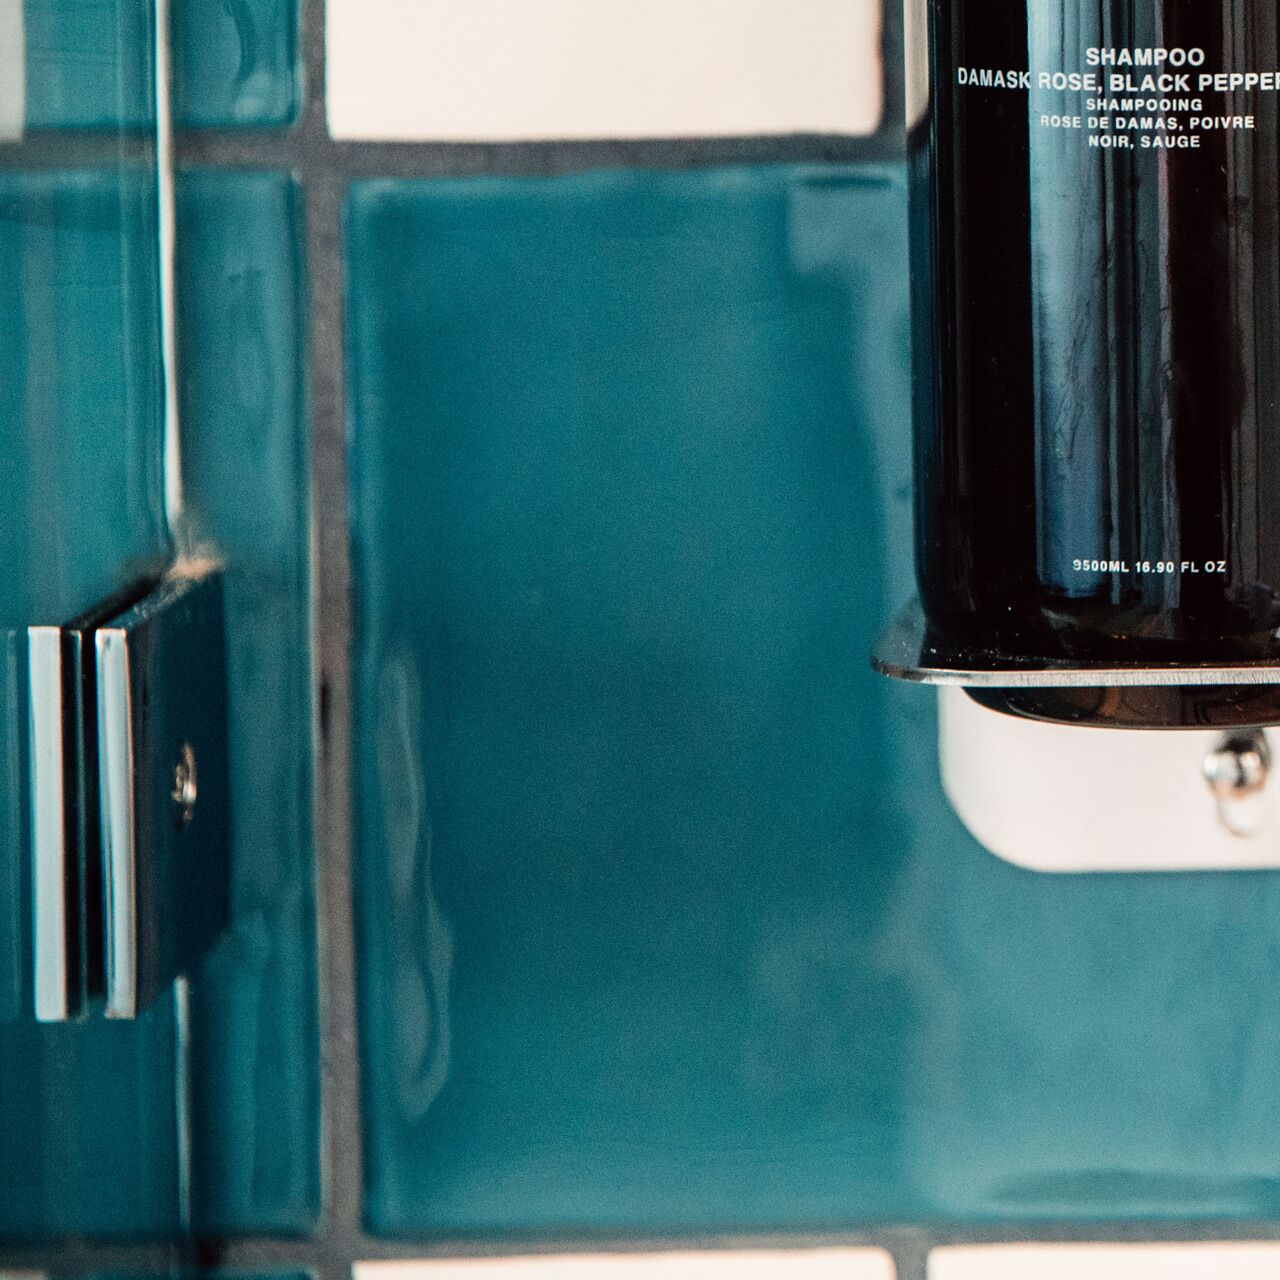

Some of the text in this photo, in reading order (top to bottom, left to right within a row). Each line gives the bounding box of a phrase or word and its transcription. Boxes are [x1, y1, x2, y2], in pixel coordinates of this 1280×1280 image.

[1086, 48, 1205, 66] SHAMPOO
[958, 67, 1031, 89] DAMASK
[1038, 73, 1103, 93] ROSE,
[1110, 74, 1190, 93] BLACK
[1086, 98, 1203, 112] SHAMPOOING
[1040, 115, 1255, 132] ROSE DE DAMAS, POIVRE
[1088, 135, 1201, 150] NOIR, SAUGE
[1135, 561, 1174, 573] 16.90
[1180, 561, 1199, 573] FL
[1204, 560, 1227, 573] OZ
